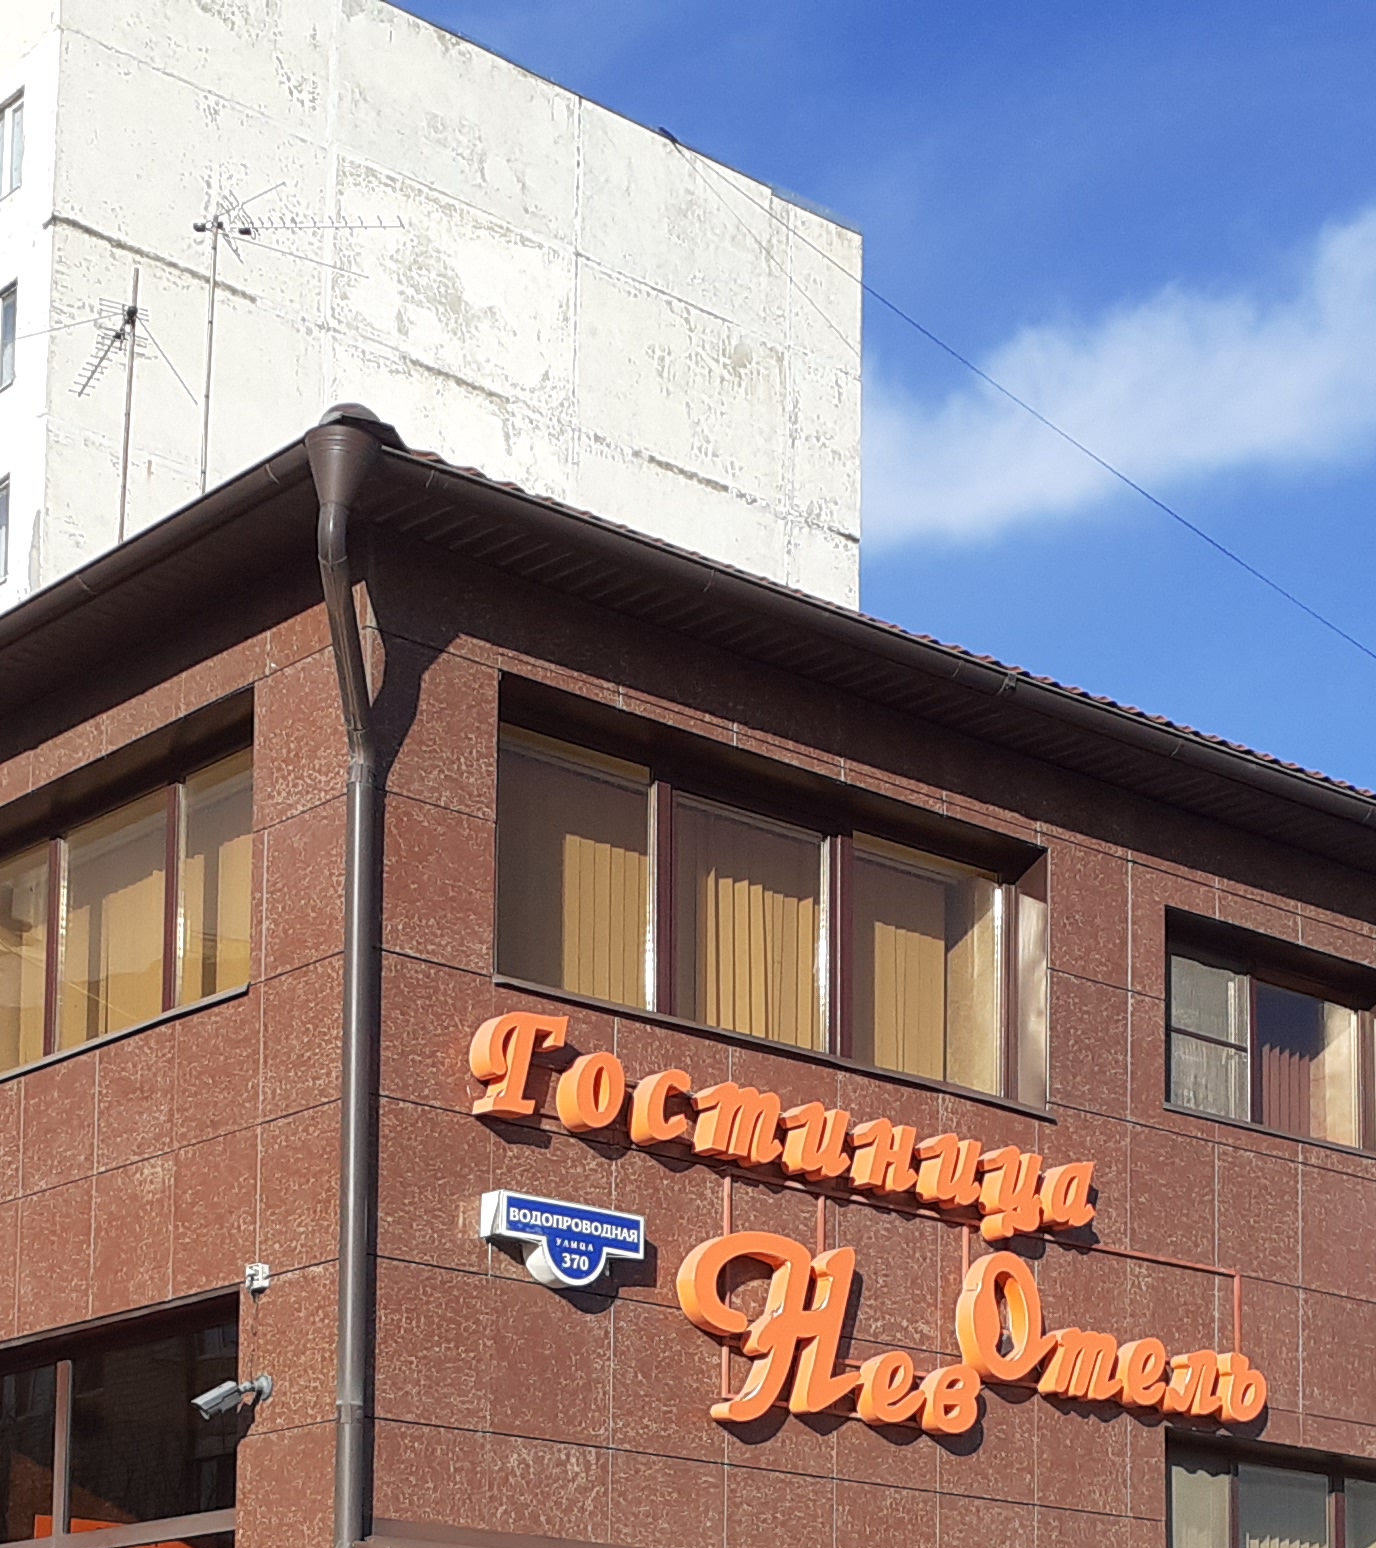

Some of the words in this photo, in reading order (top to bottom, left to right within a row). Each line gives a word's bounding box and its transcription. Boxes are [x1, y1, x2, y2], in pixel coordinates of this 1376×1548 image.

[469, 1011, 1096, 1241] Гостиница
[508, 1207, 639, 1243] ВОДОПРОВОДНАЯ
[561, 1253, 589, 1271] 370
